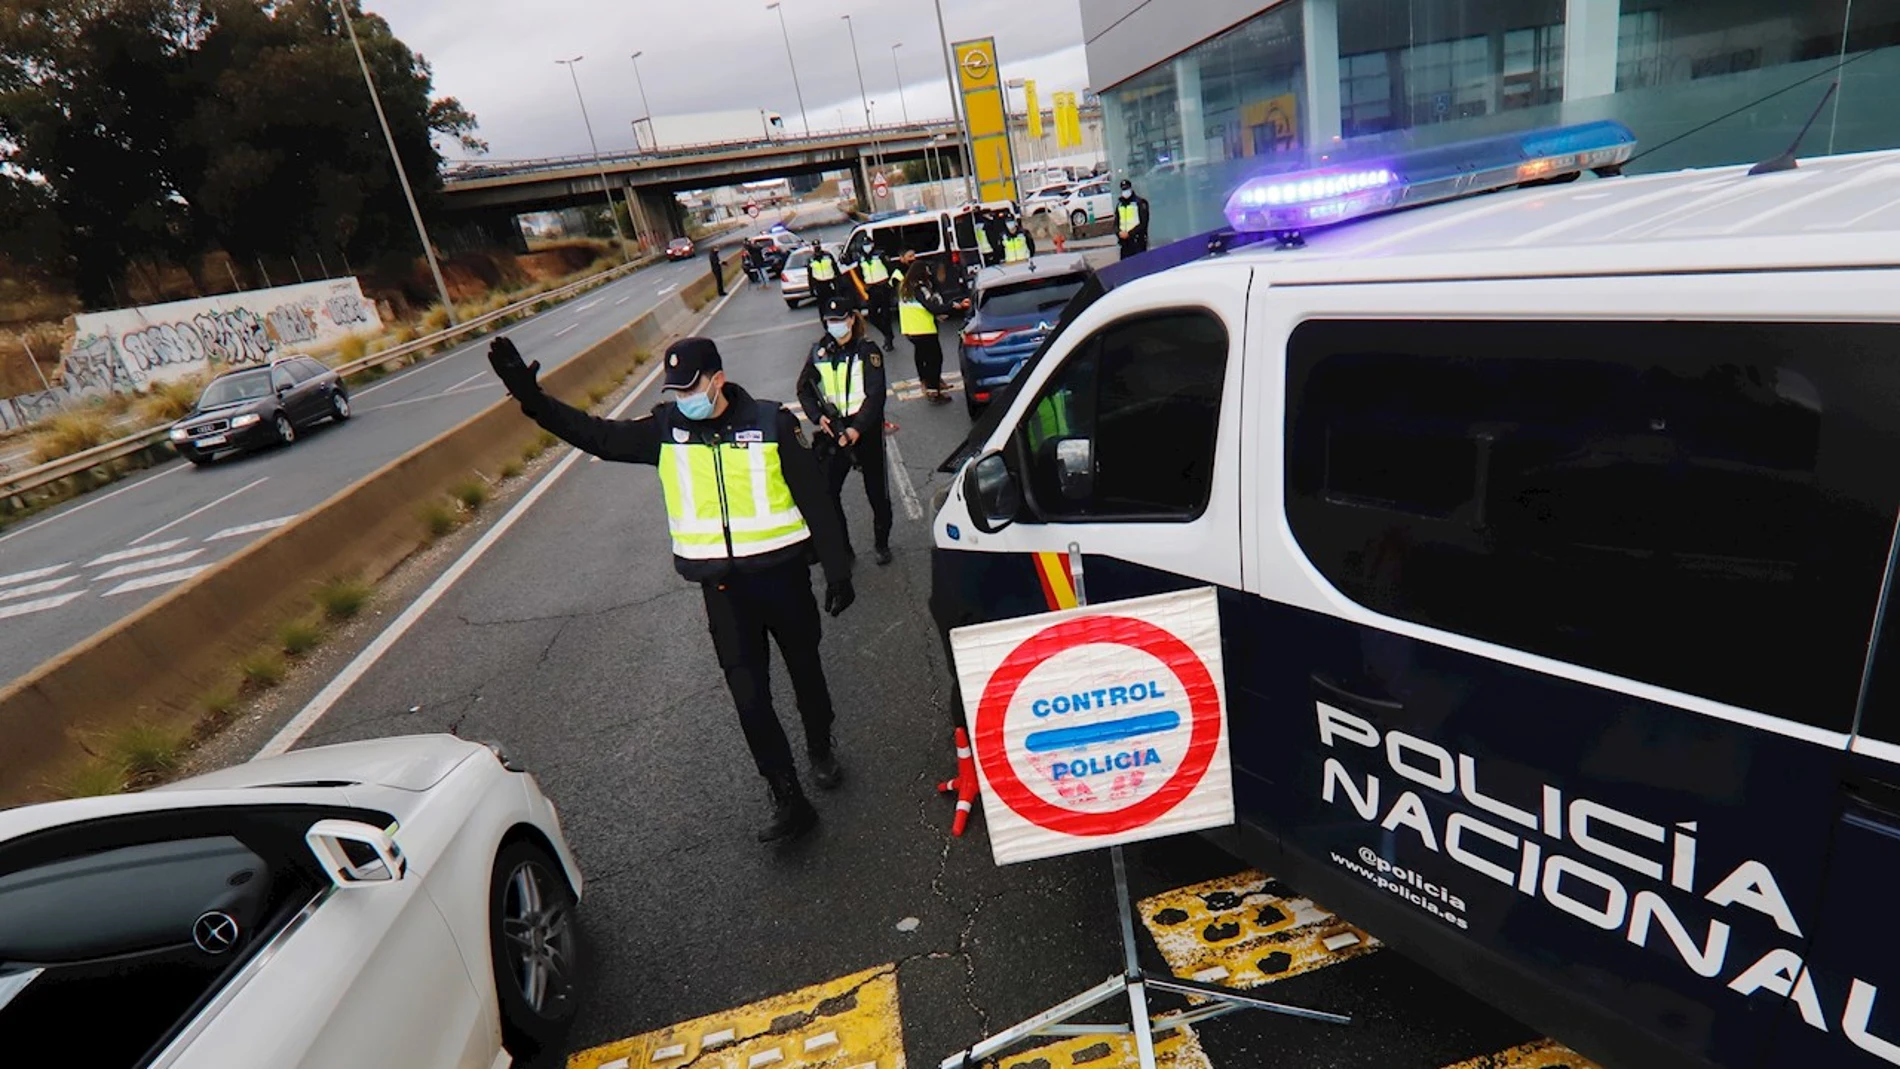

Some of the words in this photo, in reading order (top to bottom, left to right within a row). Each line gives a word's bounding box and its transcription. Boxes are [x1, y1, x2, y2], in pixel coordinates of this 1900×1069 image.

[1032, 680, 1165, 718] CONTROL
[1051, 747, 1162, 781] POLICIA
[1316, 701, 1804, 938] POLICÍA
[1322, 757, 1900, 1067] NACIONAL
[1330, 851, 1469, 930] www.policia.es
[1357, 846, 1467, 912] @policia
